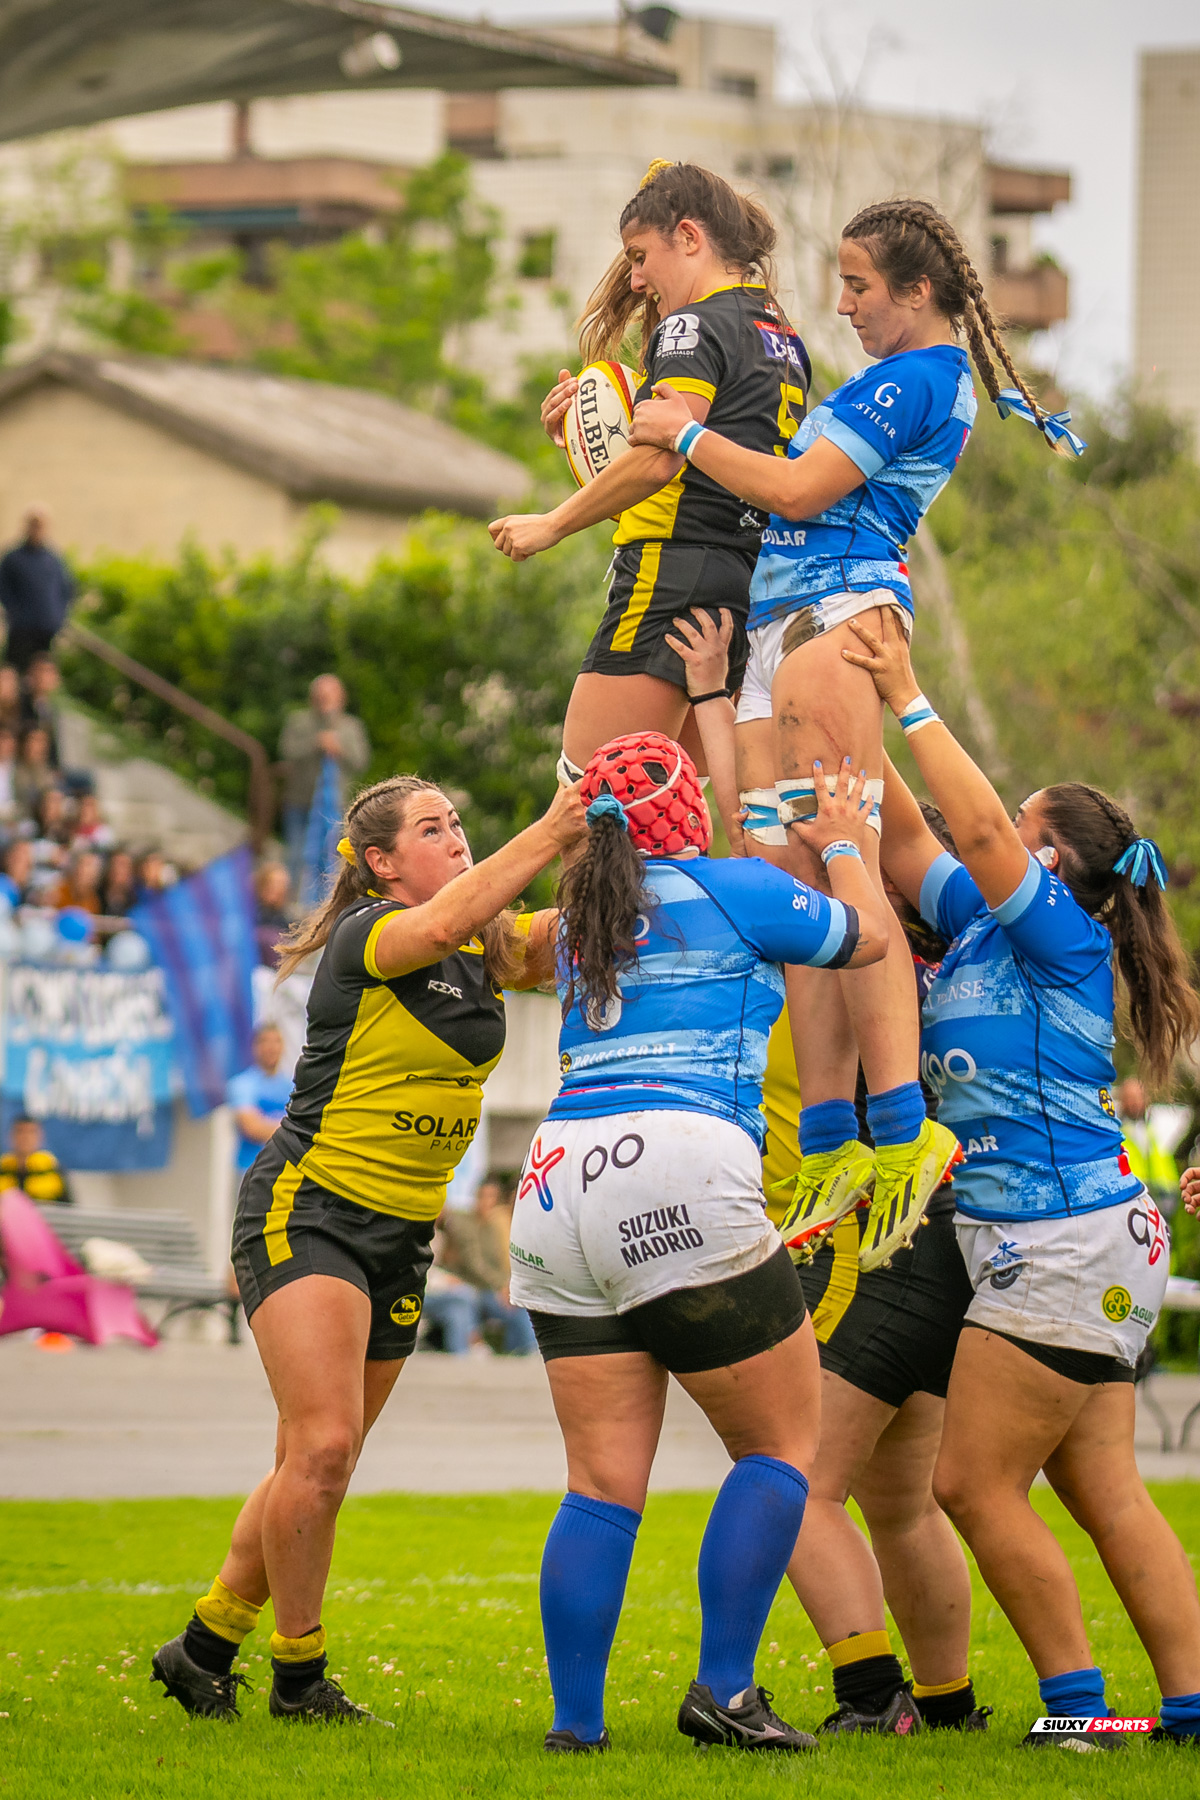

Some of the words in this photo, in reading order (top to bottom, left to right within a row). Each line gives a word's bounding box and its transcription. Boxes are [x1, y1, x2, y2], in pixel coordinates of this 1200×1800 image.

[851, 402, 896, 439] STILAR
[391, 1110, 478, 1138] SOLAR
[618, 1204, 691, 1244] SUZUKI
[620, 1227, 705, 1269] MADRID
